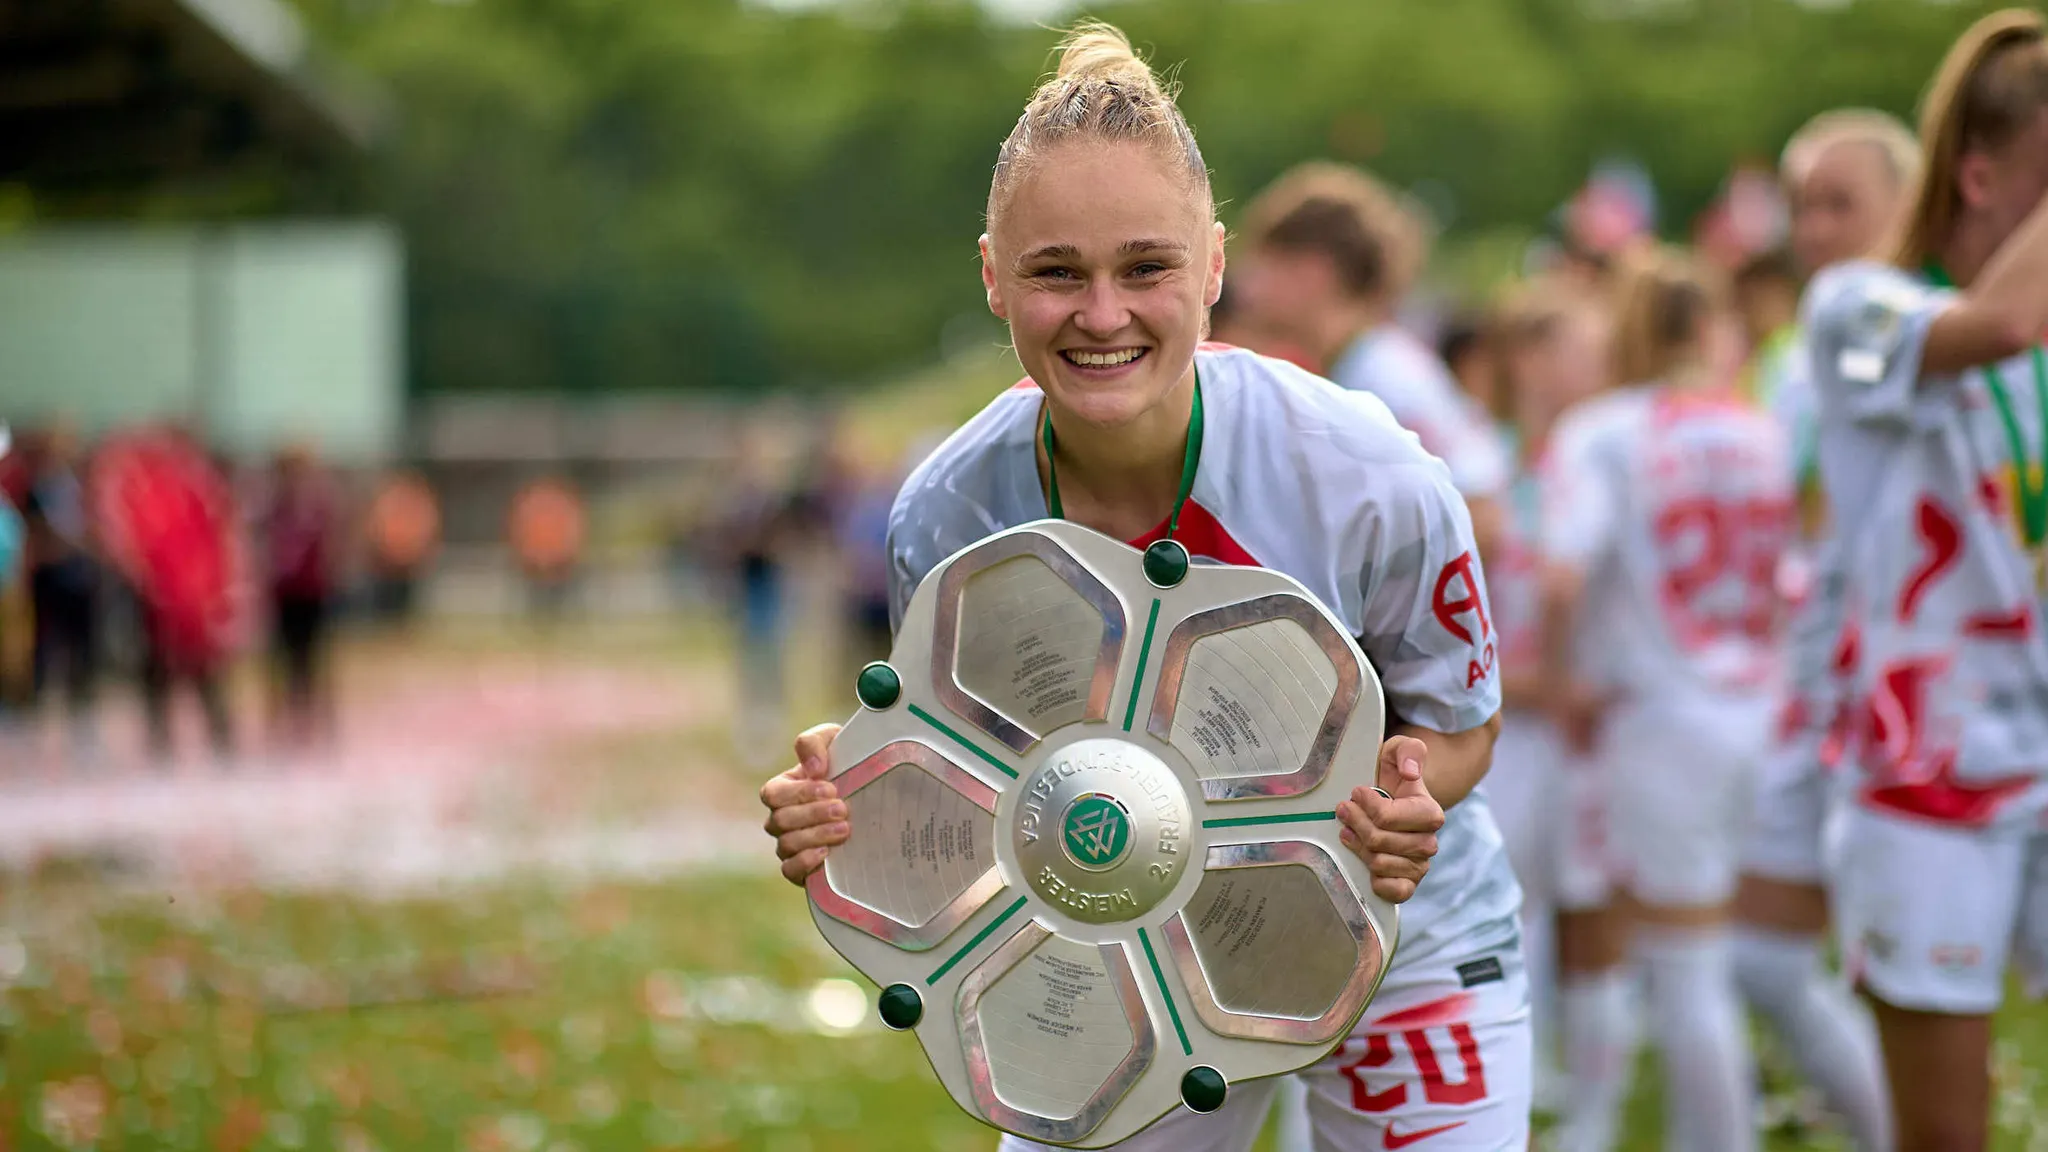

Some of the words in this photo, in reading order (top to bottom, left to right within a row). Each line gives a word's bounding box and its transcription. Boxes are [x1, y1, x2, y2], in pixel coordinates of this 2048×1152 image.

[1038, 866, 1137, 912] MEISTER
[1150, 861, 1173, 883] 2.
[1332, 1022, 1488, 1114] 20
